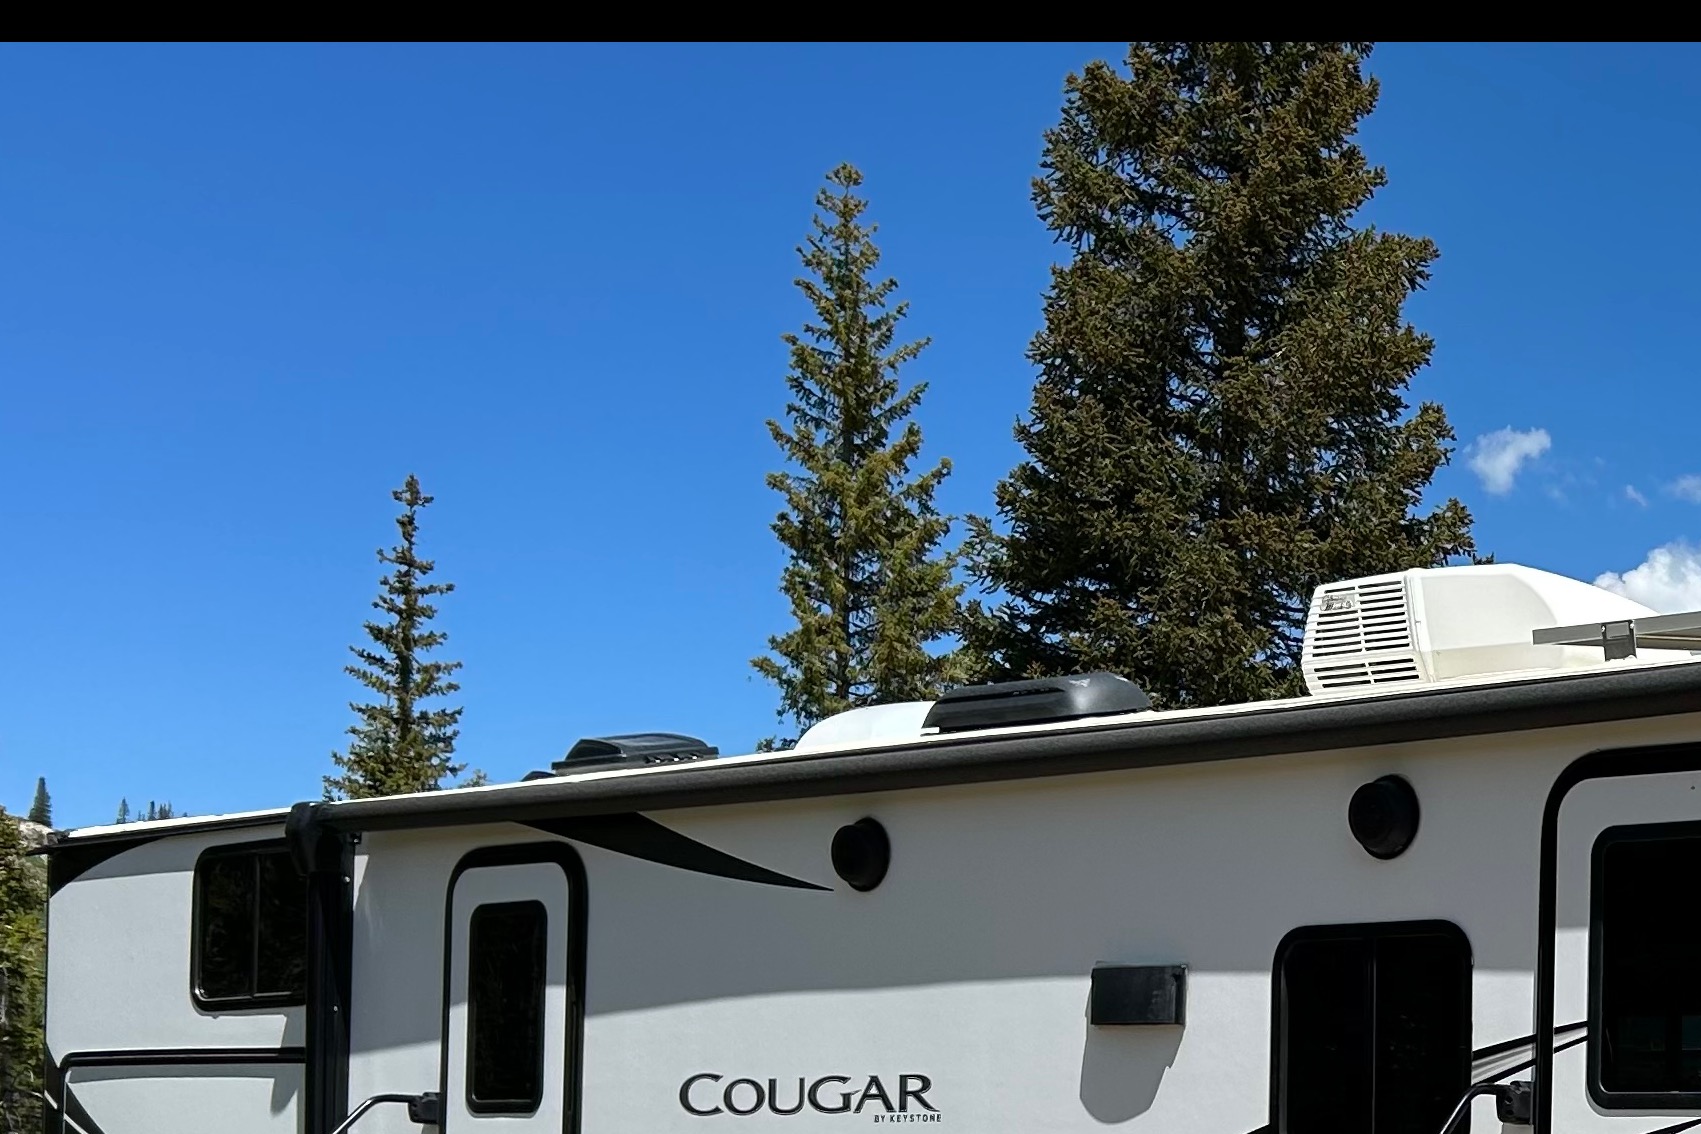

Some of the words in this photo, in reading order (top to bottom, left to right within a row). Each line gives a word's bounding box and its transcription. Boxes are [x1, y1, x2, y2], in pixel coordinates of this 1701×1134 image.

[679, 1072, 941, 1116] COUGAR
[874, 1114, 886, 1123] BY
[889, 1114, 942, 1123] KEYSTONE
